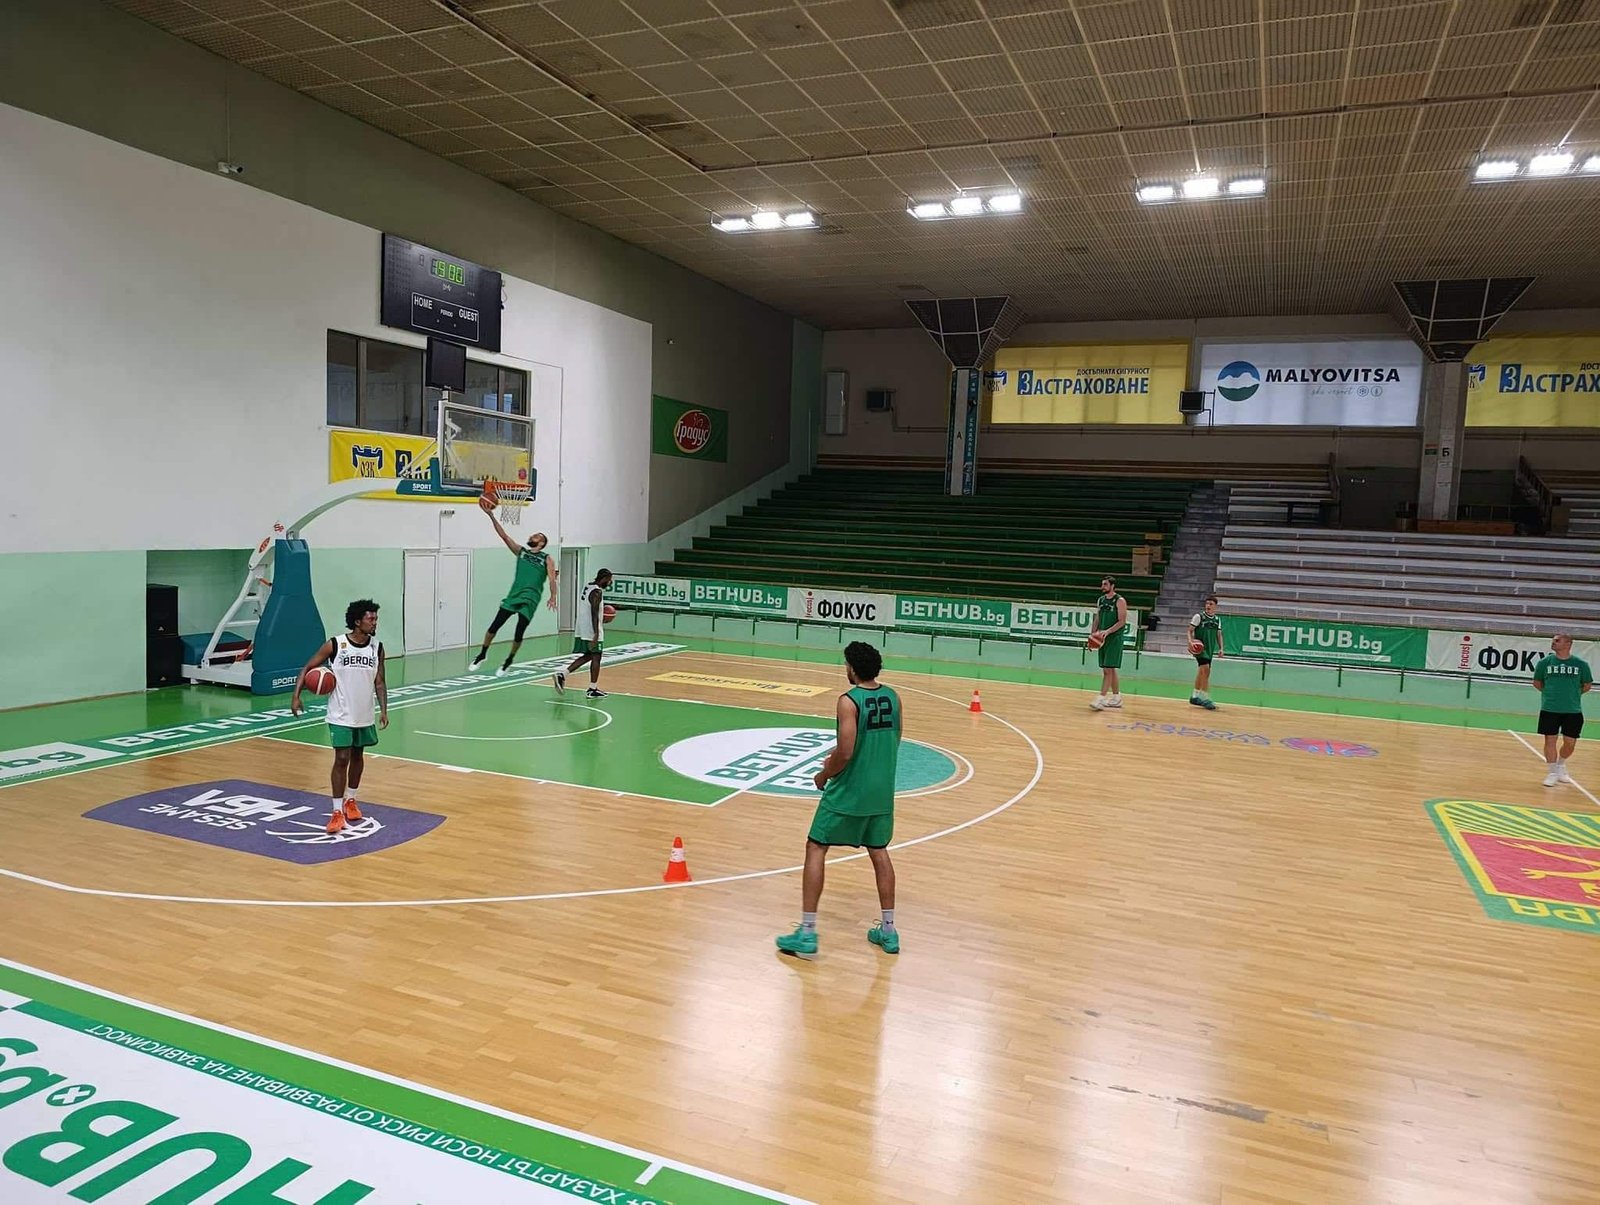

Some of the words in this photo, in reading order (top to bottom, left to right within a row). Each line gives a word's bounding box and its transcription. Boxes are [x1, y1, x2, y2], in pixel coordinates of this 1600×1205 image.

[414, 296, 432, 309] HOME
[459, 309, 477, 321] GUEST
[1019, 371, 1149, 394] ЗАСТРАХОВАНЕ
[1266, 368, 1400, 382] MALYOVITSA
[1442, 448, 1450, 457] Б
[695, 585, 782, 608] BETHUB.bg
[818, 599, 876, 620] ФОКУС
[901, 600, 1005, 625] BETHUB.bg
[1249, 624, 1382, 654] BETHUB.bg
[343, 655, 375, 667] BEROE
[1547, 665, 1579, 675] BEROE
[272, 676, 298, 687] SPORT
[865, 696, 893, 730] 22
[0, 751, 86, 769] bg
[706, 732, 837, 781] BETHUB
[138, 803, 257, 830] SESAME
[85, 1024, 206, 1067] ЗАВИСИМОСТ
[202, 1060, 233, 1076] НА
[230, 1069, 346, 1113] РАЗВИВАНЕ
[342, 1106, 375, 1122] ОТ
[372, 1115, 432, 1142] РИСК
[431, 1132, 501, 1164] НОСИ
[498, 1154, 625, 1205] ХАЗАРТЪТ
